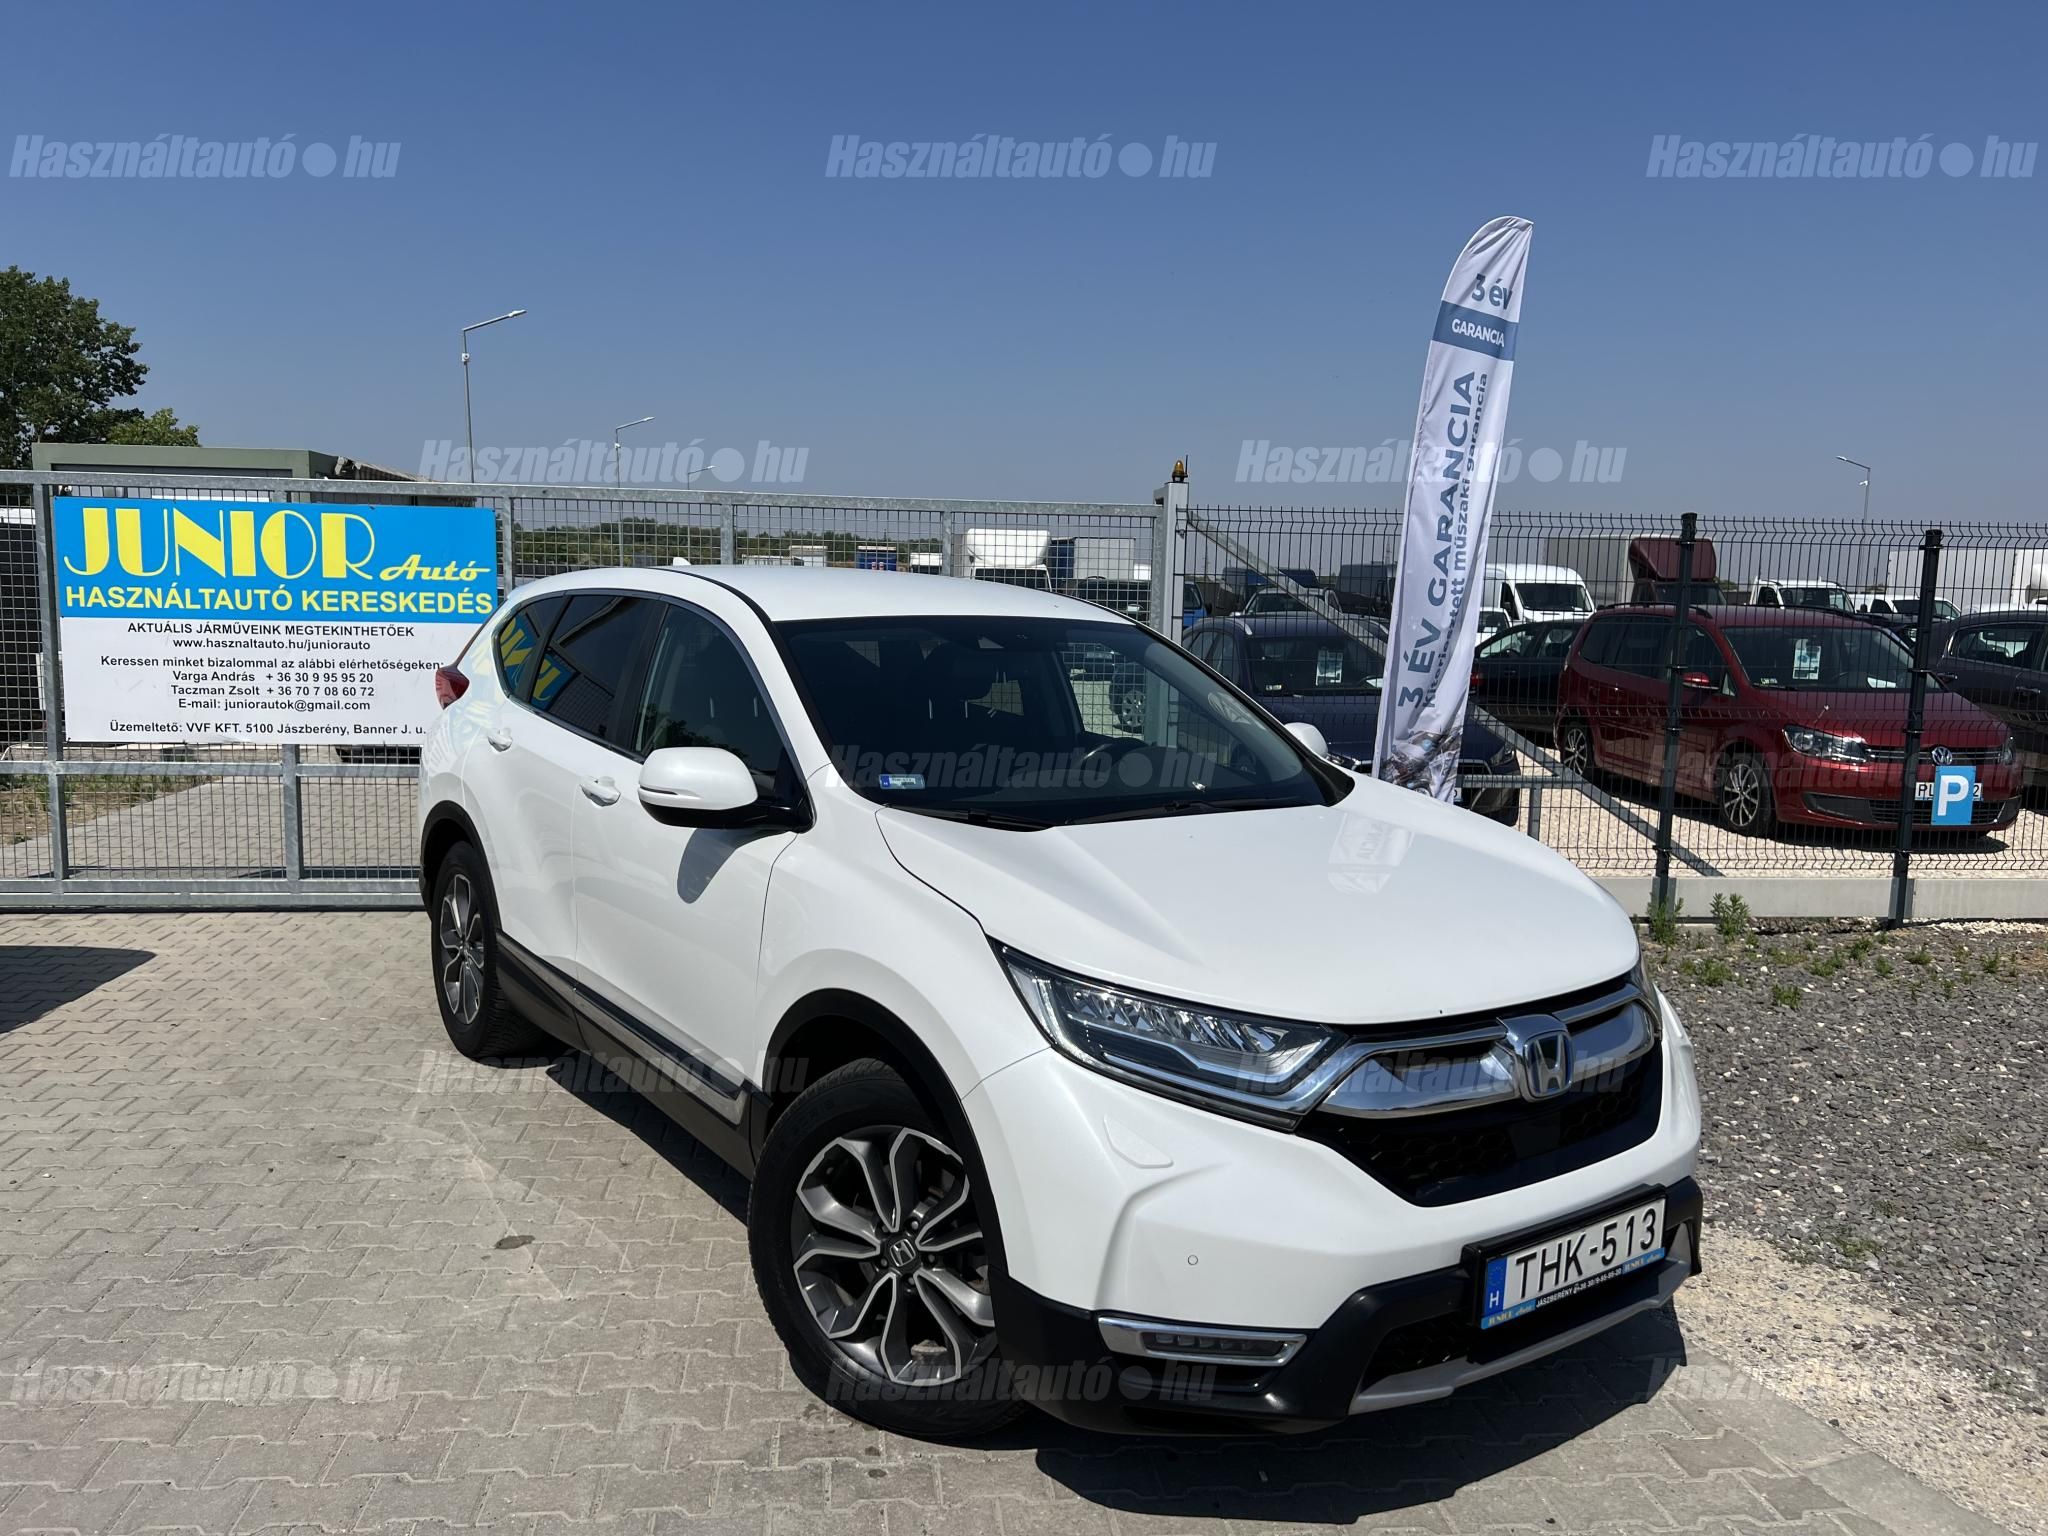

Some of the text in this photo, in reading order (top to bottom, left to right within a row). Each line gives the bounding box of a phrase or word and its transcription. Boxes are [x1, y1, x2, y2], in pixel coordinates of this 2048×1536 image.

[1472, 273, 1513, 310] 3 év
[1452, 318, 1505, 348] GARANCIA
[1456, 478, 1471, 573] műszaki
[1466, 373, 1489, 472] garancia
[64, 507, 491, 582] JUNIOR Autó
[1398, 371, 1476, 709] 3 ÉV GARANCIA
[66, 582, 493, 614] HASZNÁLTAUTÓ KERESKEDÉS
[128, 621, 415, 637] AKTUÁLIS JÁRMŰVEINK MEGTEKINTHETŐEK
[173, 639, 371, 651] www.hasznaltauto.hu/juniorauto
[101, 656, 159, 667] Keressen
[163, 657, 204, 667] minket
[208, 658, 278, 668] bizalommal
[281, 660, 294, 668] az
[298, 659, 335, 669] alábbi
[172, 671, 208, 683] Varga
[211, 671, 255, 682] András
[277, 672, 291, 682] 36
[295, 672, 309, 682] 30
[312, 672, 320, 682] 9
[323, 672, 338, 683] 95
[341, 673, 355, 683] 95
[359, 673, 373, 683] 20
[171, 685, 225, 695] Taczman
[229, 685, 260, 695] Zsolt
[278, 686, 292, 696] 36
[295, 686, 310, 696] 70
[314, 687, 320, 696] 7
[324, 687, 338, 696] 08
[342, 687, 356, 696] 60
[360, 687, 374, 696] 72
[178, 698, 371, 712] E-mail: juniorautok@gmail.com
[110, 719, 426, 736] Üzemeltető: VVF KFT. 5100 Jászberény, Banner J. u.
[1489, 1207, 1656, 1309] H THK-513
